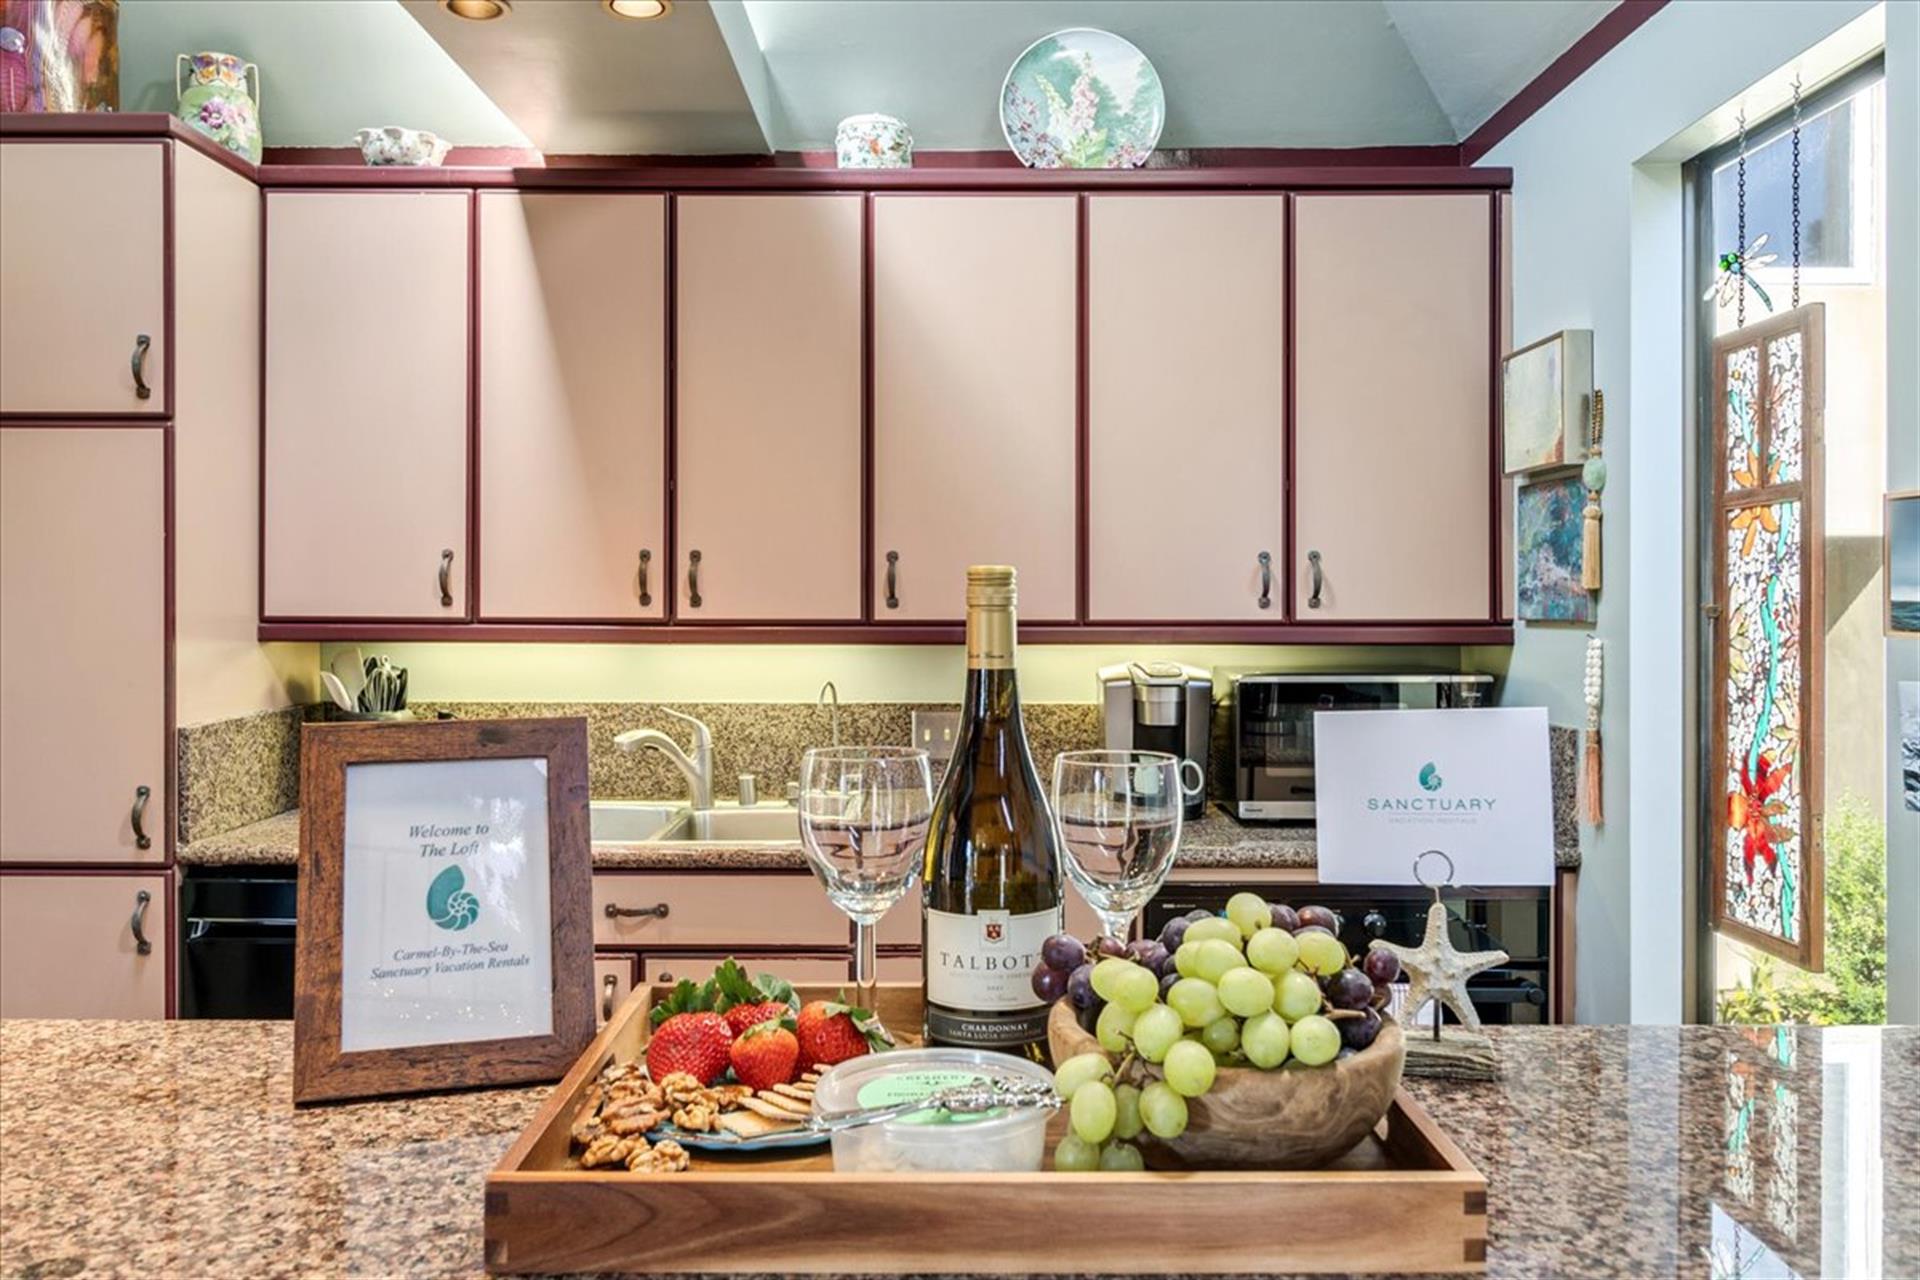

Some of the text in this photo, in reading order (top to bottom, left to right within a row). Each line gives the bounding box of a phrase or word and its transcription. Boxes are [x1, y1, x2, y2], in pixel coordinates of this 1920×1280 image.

[1367, 797, 1497, 811] SANCTUARY
[409, 824, 490, 838] Welcome to
[420, 840, 480, 858] The Loft
[393, 940, 509, 962] Carmel-By-The-Sea
[370, 954, 530, 980] Sanctuary Vacation Rentals
[940, 951, 1042, 970] TALBOT
[961, 1023, 1028, 1033] CHARDONNAY
